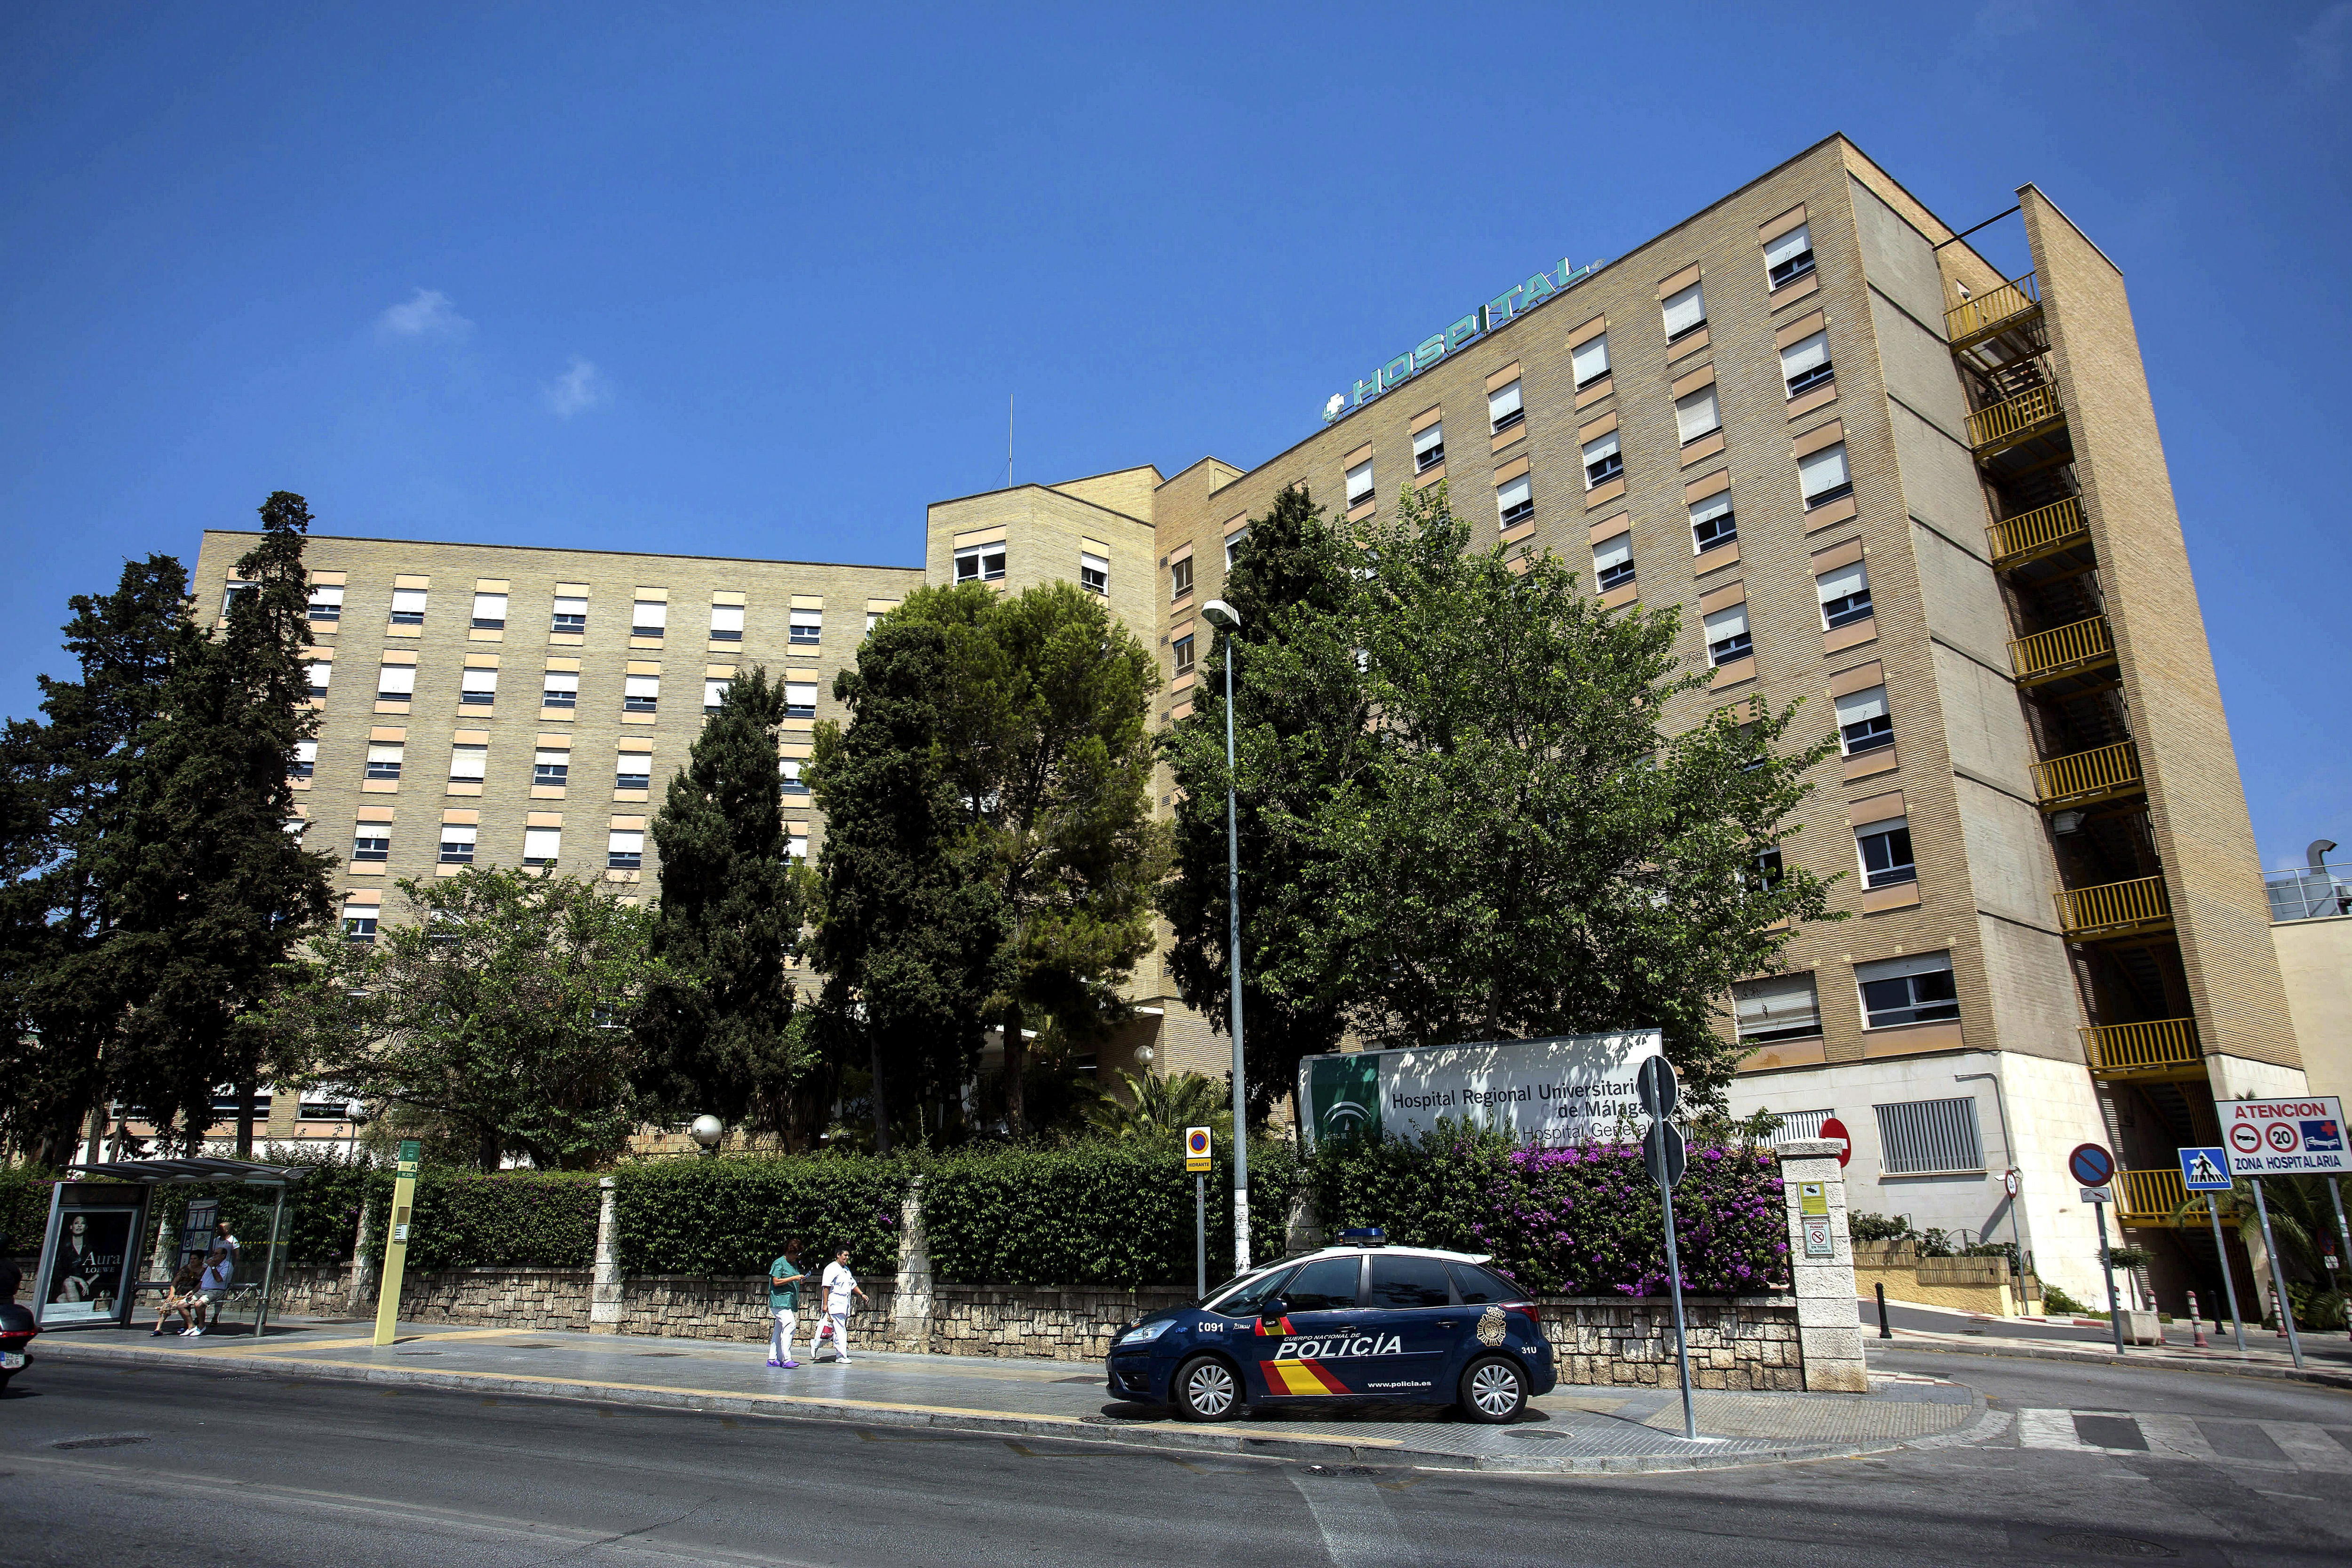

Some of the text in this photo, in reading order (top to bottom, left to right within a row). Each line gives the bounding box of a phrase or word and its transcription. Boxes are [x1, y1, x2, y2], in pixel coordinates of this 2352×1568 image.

[1353, 256, 1590, 407] HOSPITAL
[1392, 1078, 1639, 1111] Hospital Regional Universitari
[1558, 1104, 1578, 1118] de
[2235, 1102, 2327, 1119] ATENCION
[1523, 1120, 1650, 1143] Hospital Geneal
[2273, 1130, 2290, 1145] 20
[2234, 1154, 2343, 1170] ZONA HOSPITALARIA
[82, 1251, 120, 1266] Aura
[1204, 1322, 1223, 1332] 091
[1274, 1332, 1401, 1360] POLICÍA
